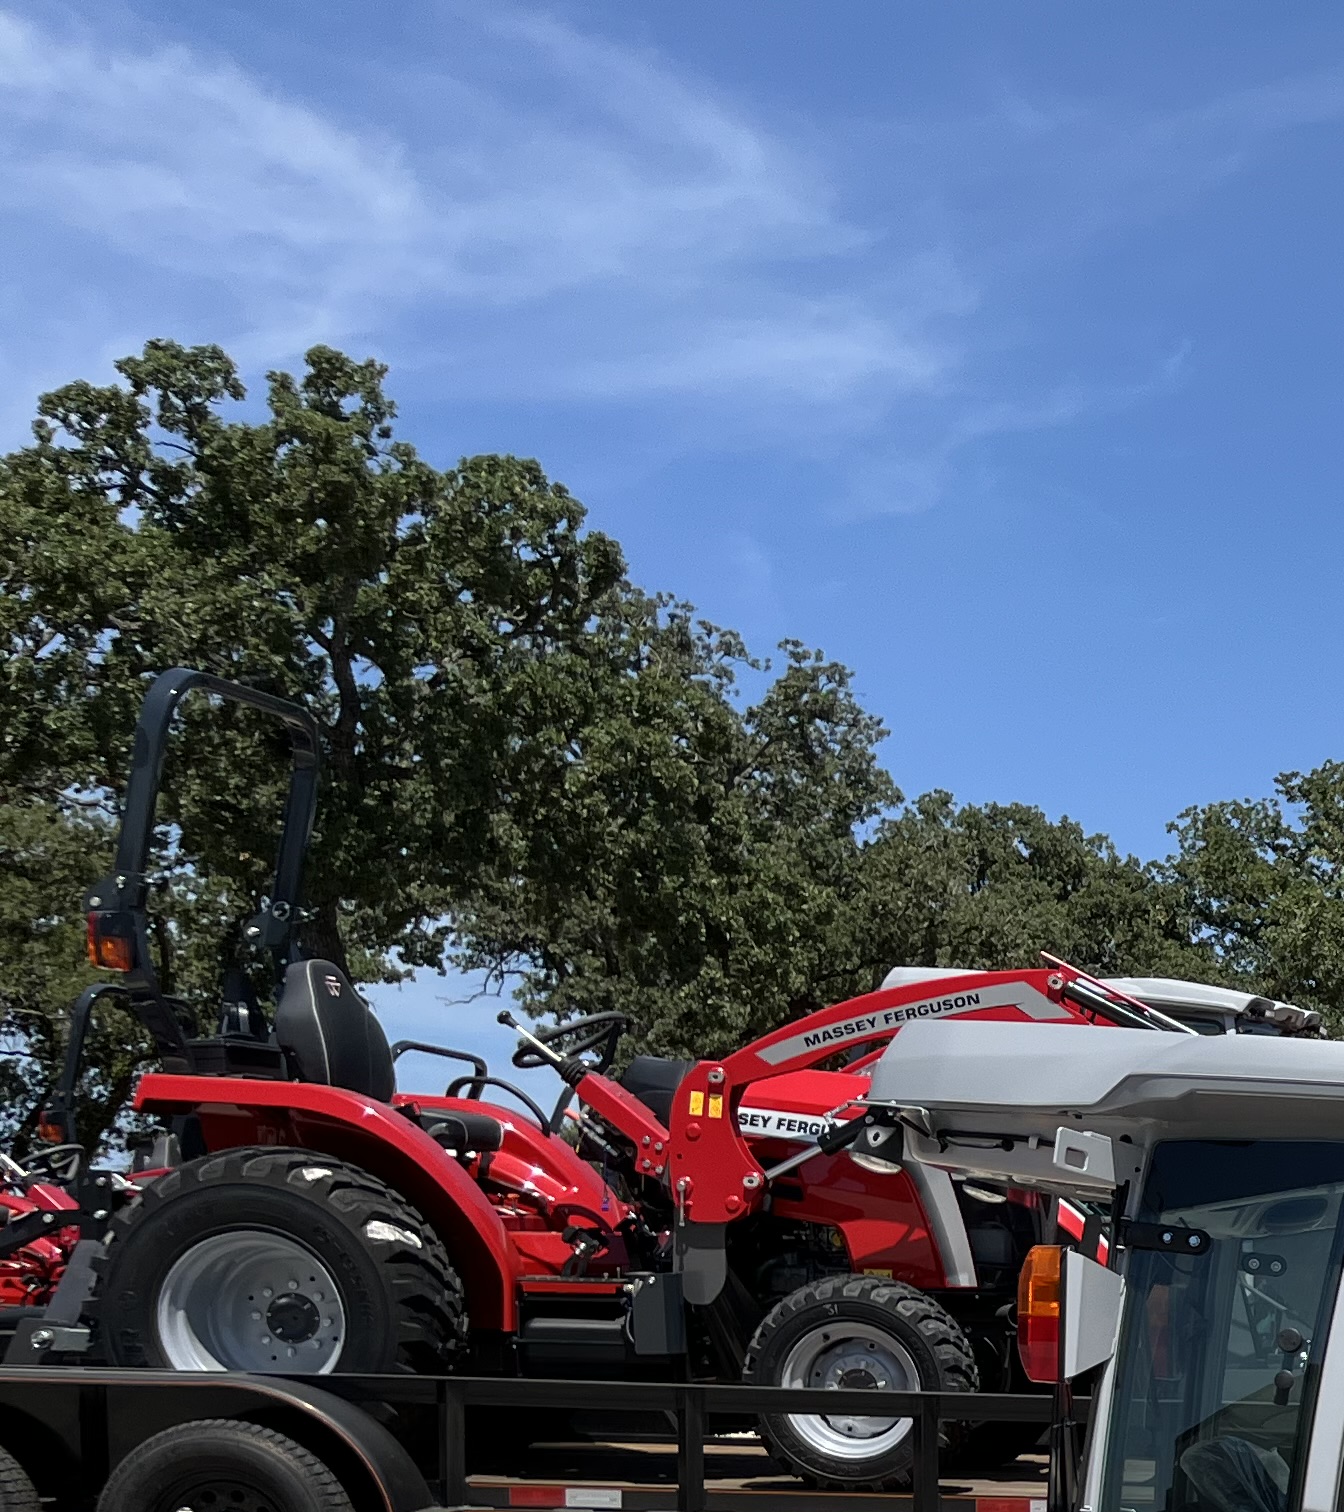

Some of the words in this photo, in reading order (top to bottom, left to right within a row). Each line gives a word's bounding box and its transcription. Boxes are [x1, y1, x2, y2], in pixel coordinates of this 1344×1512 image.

[803, 1016, 877, 1048] MASSEY
[883, 993, 981, 1025] FERGUSON
[738, 1112, 773, 1129] SEY
[775, 1117, 831, 1137] FERG
